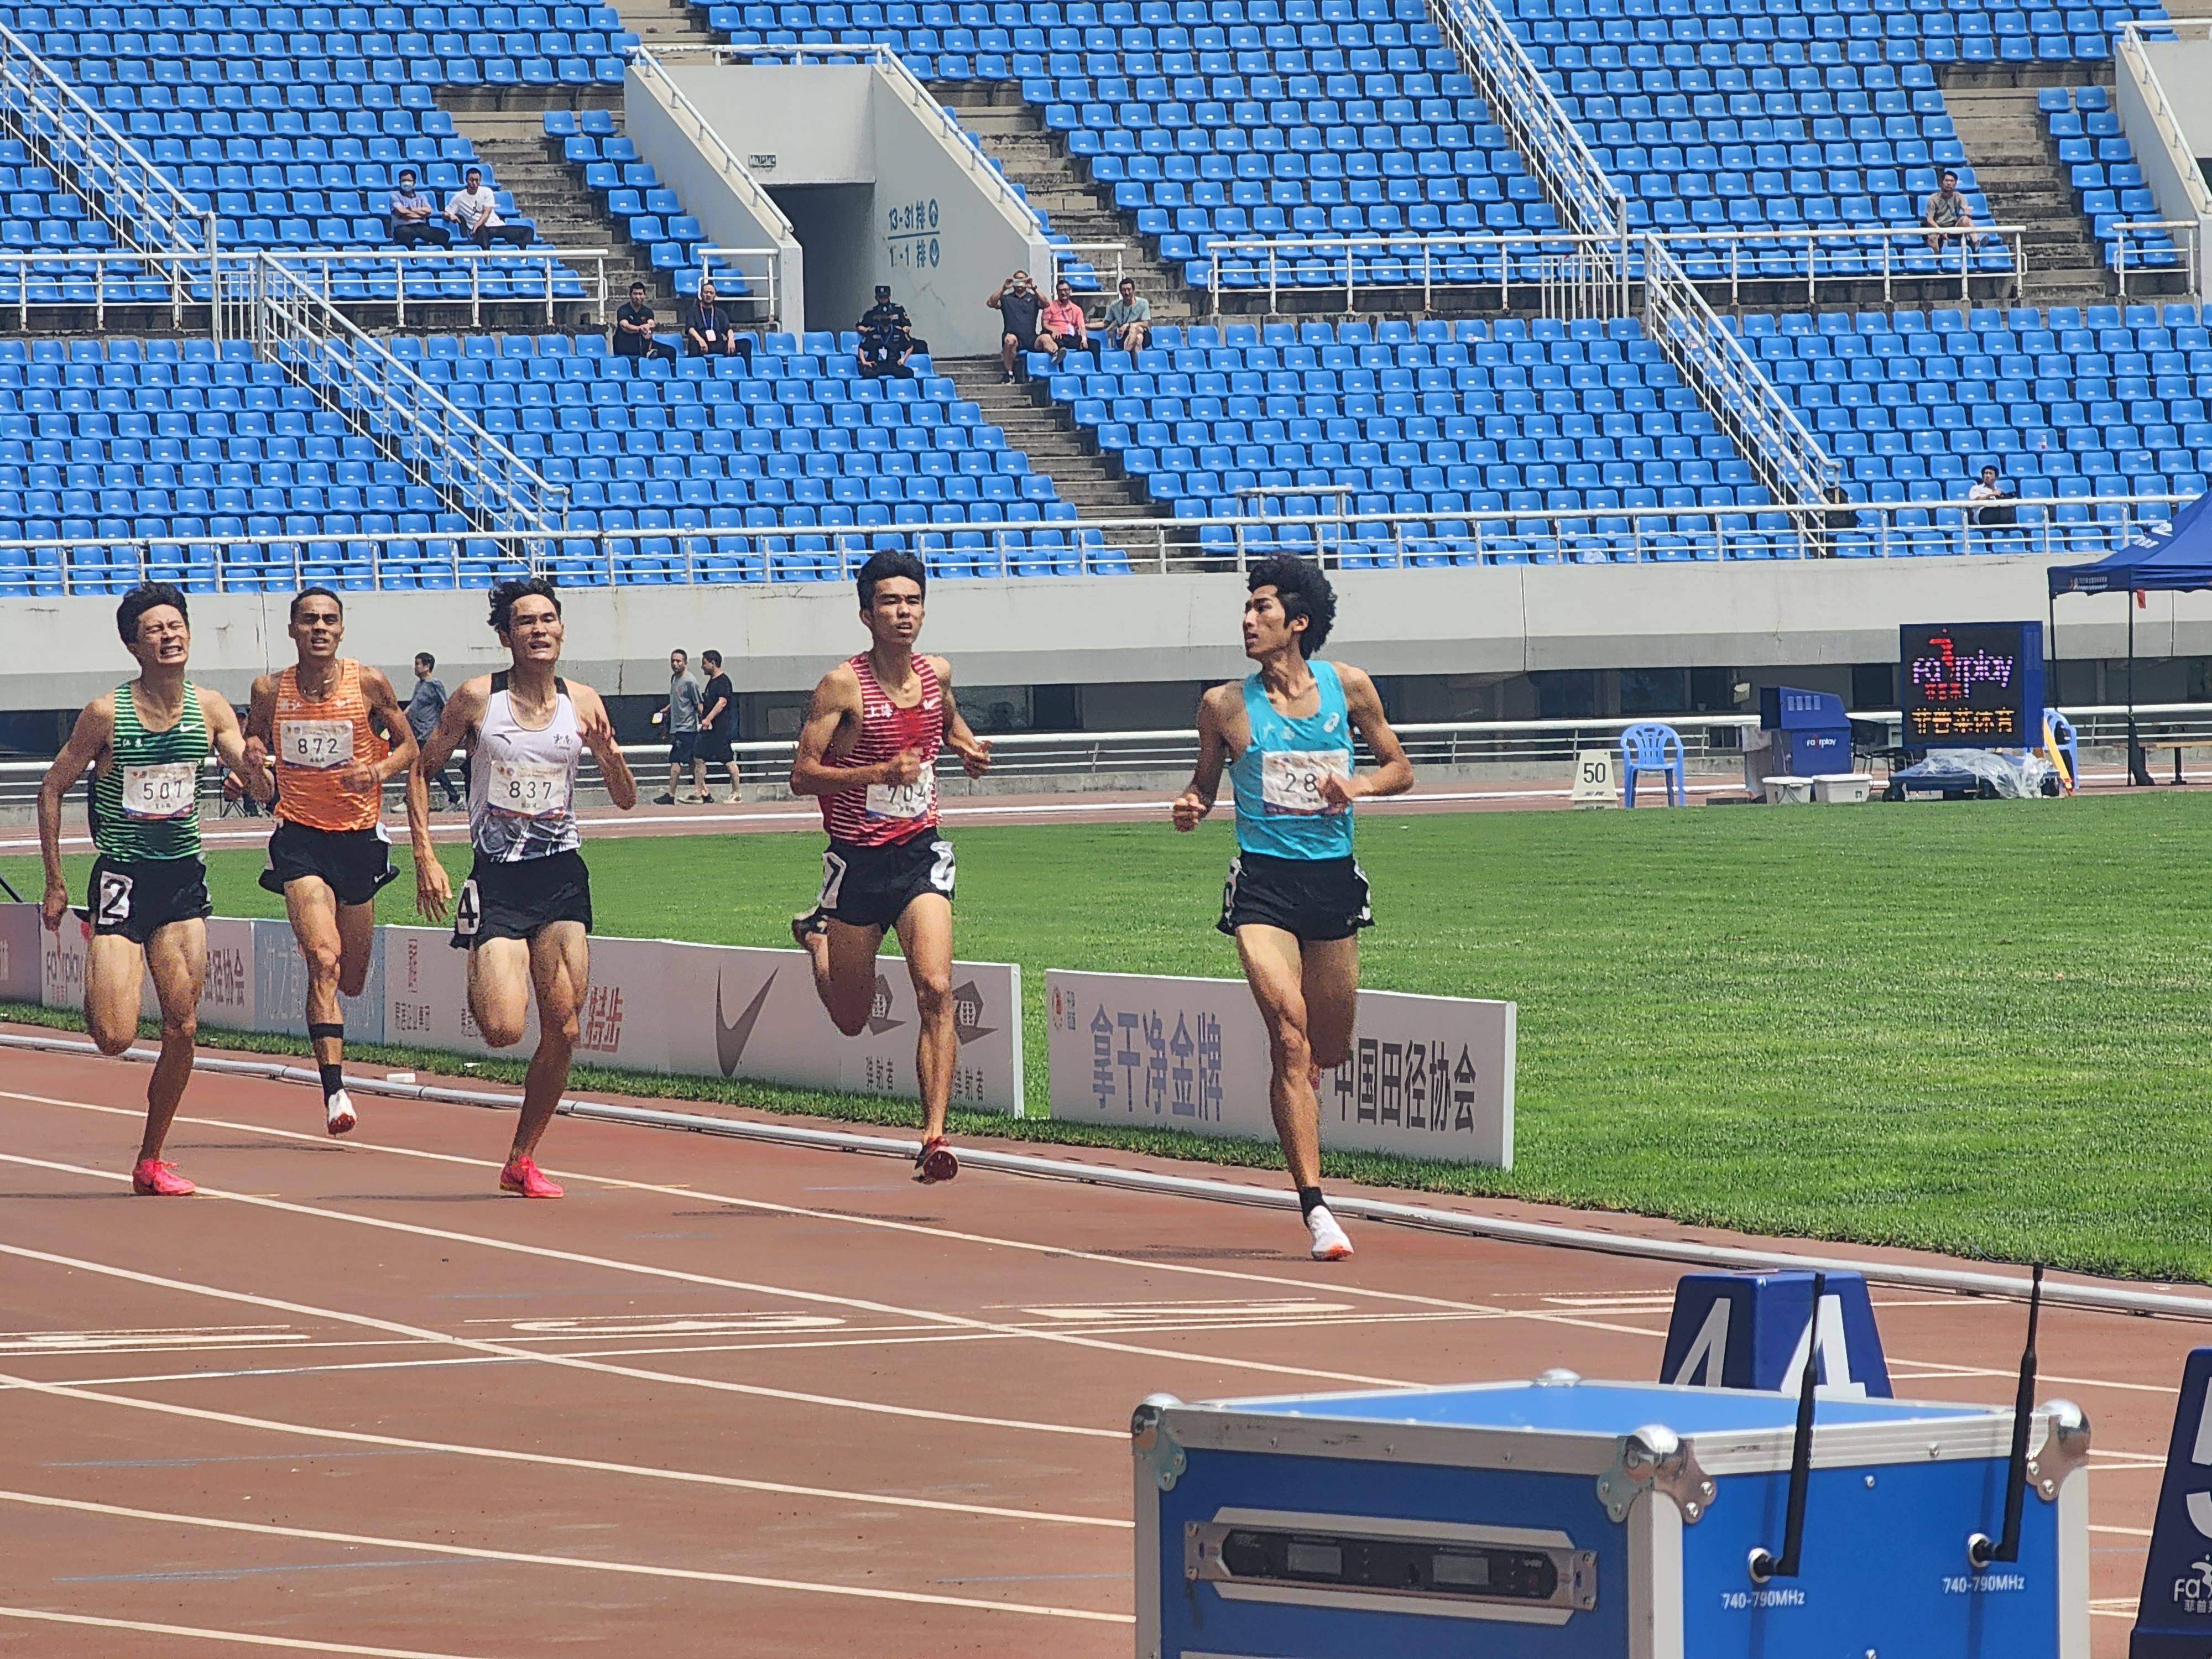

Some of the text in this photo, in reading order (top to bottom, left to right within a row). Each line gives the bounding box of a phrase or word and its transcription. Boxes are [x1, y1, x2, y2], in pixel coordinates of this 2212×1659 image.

[298, 738, 339, 754] 872
[1583, 762, 1606, 784] 50
[143, 780, 183, 800] 507
[509, 780, 552, 799] 837
[102, 878, 127, 919] 2
[458, 886, 478, 928] 4
[1091, 1003, 1223, 1121] 拿干净金牌
[1334, 1037, 1477, 1134] 中国田径协会
[1781, 1295, 1866, 1400] 4
[1942, 1575, 2025, 1594] 740-790MHz
[1721, 1590, 1805, 1610] 740-790MHz
